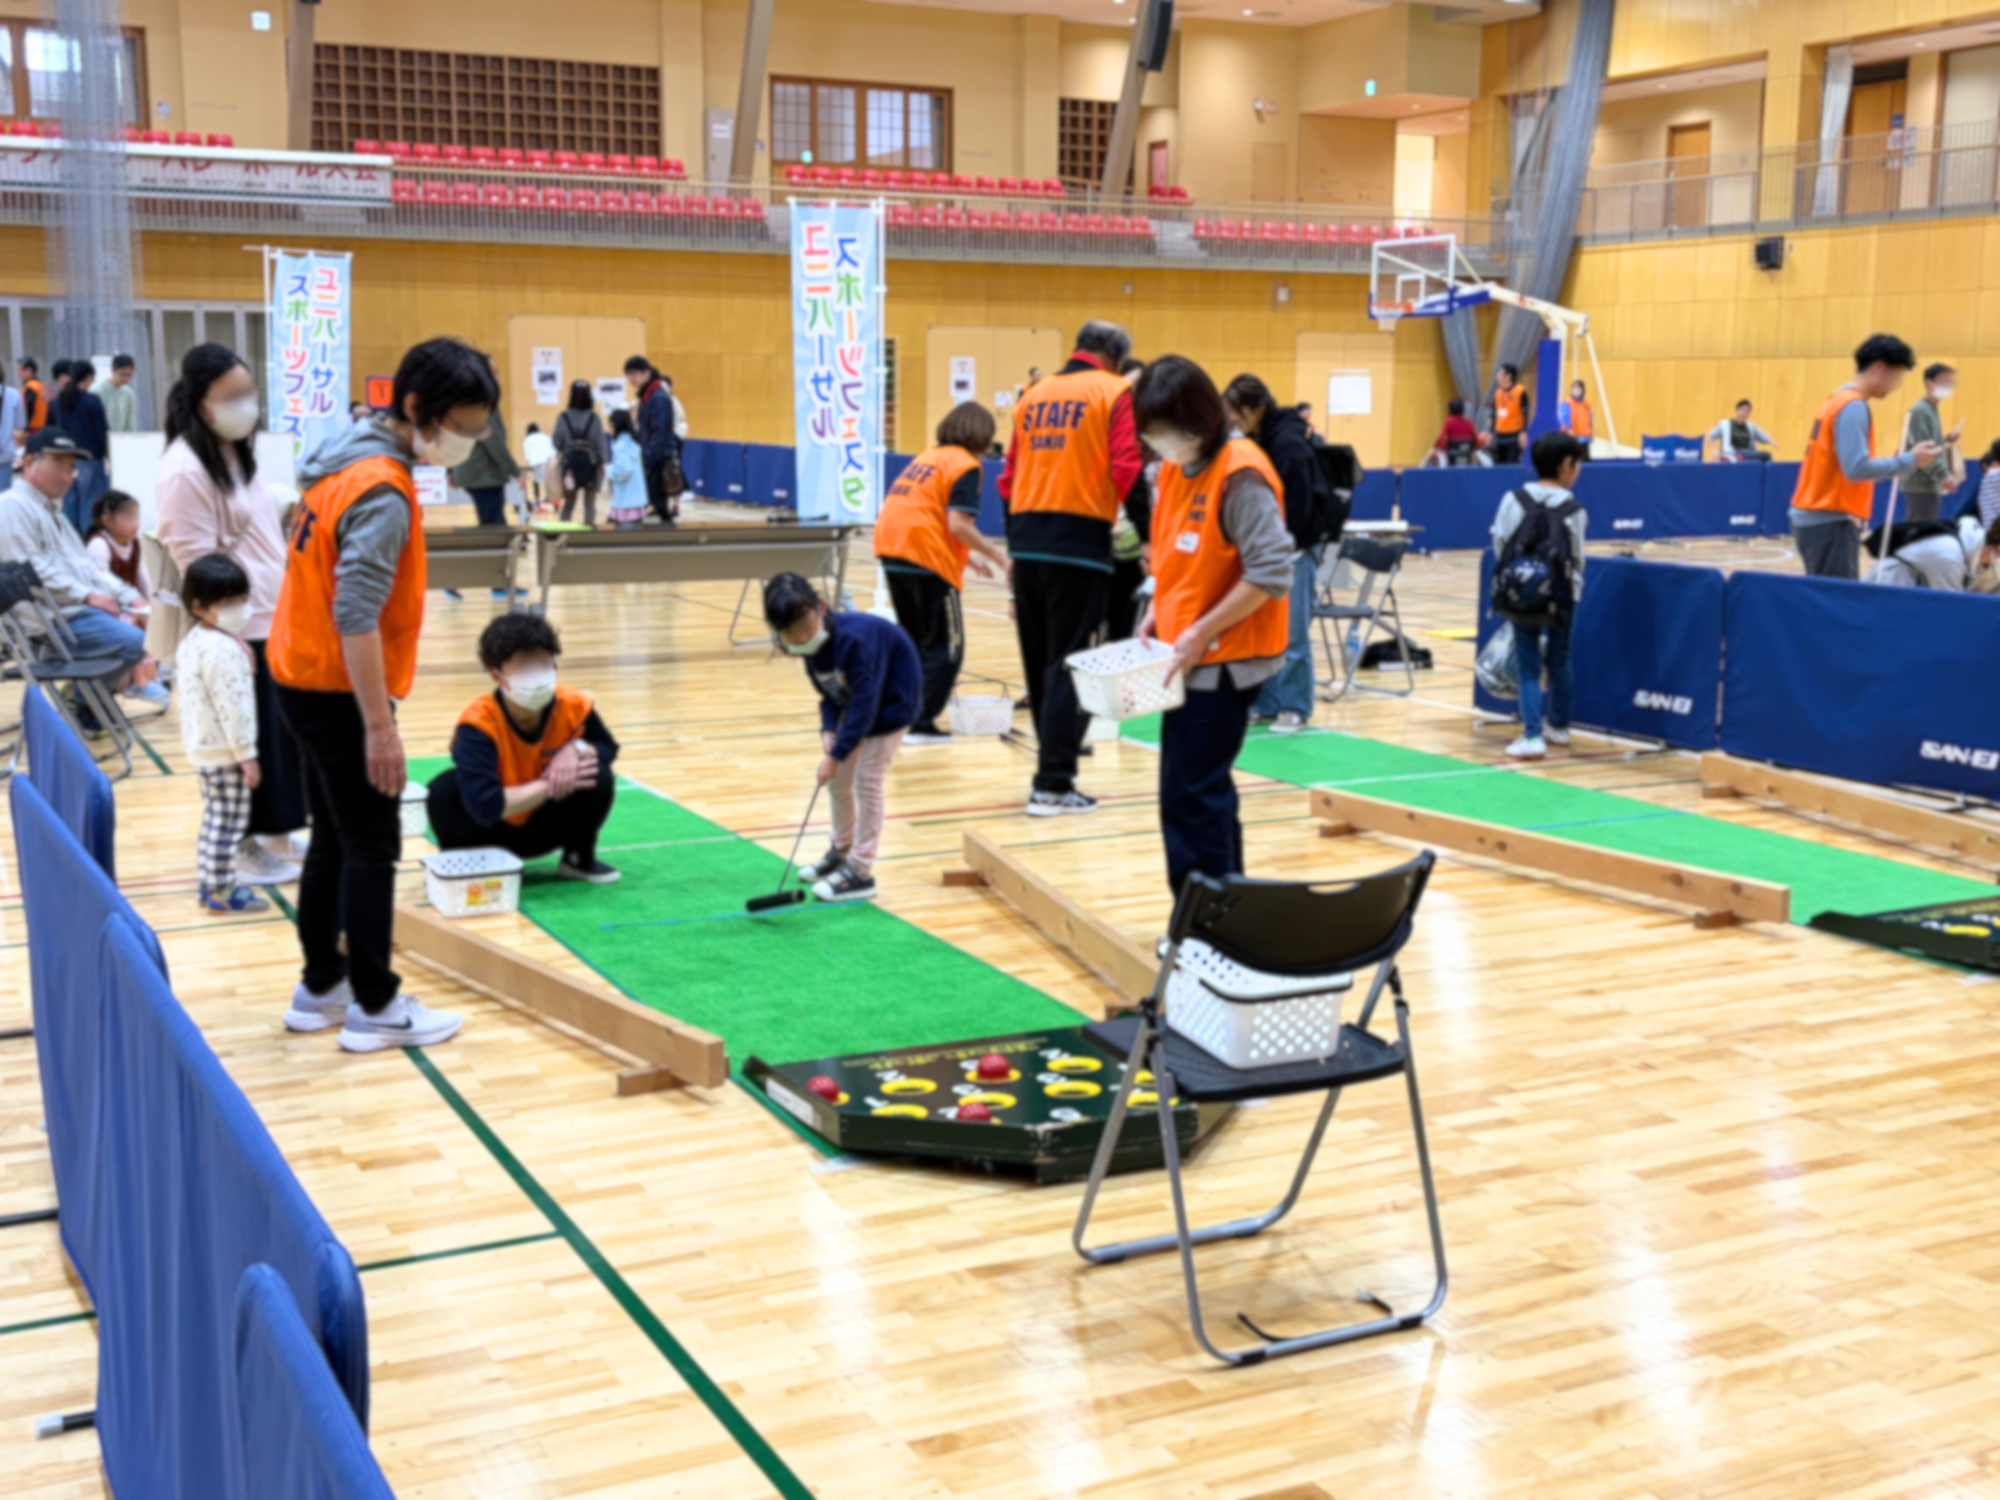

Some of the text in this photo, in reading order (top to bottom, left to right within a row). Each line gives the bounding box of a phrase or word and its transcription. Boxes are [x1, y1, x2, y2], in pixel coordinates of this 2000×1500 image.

[282, 275, 309, 456] スポーツフェス
[310, 268, 338, 414] ユニバーサル
[1023, 400, 1089, 433] STAFF
